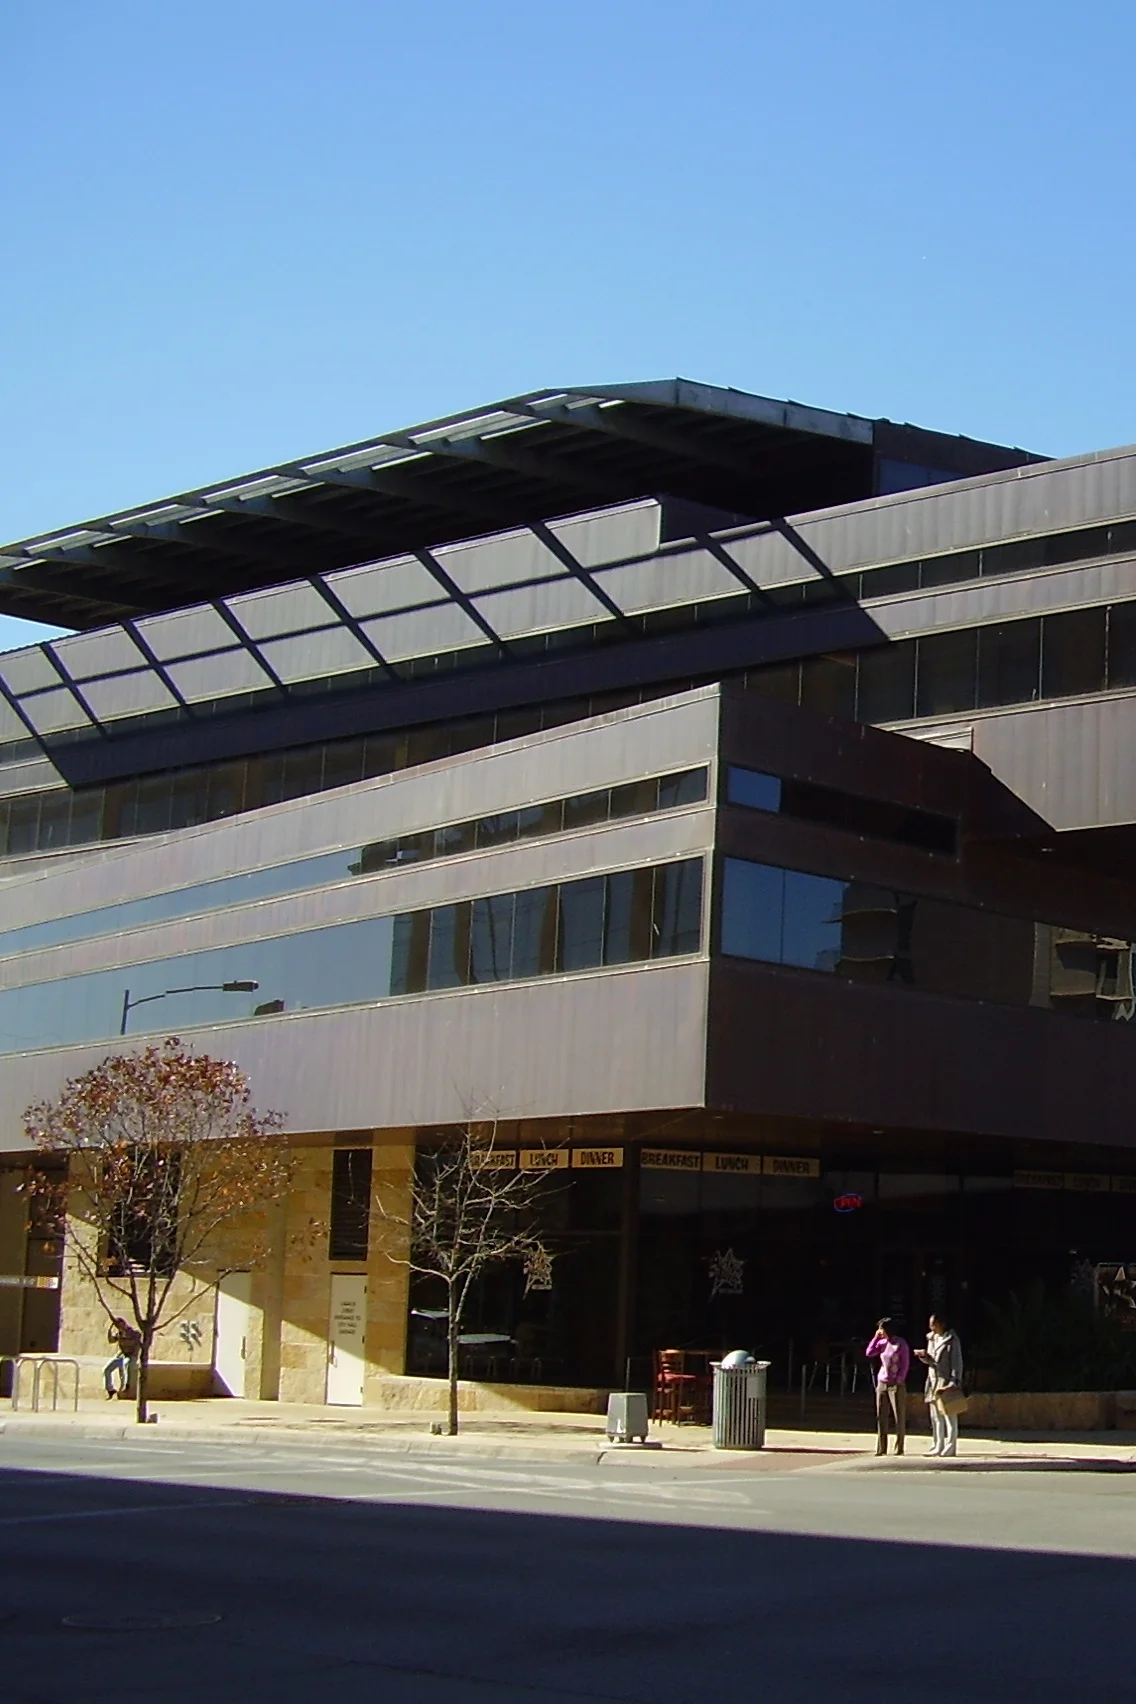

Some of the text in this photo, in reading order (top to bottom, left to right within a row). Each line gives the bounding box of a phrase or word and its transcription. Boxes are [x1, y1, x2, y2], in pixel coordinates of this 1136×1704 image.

[580, 1151, 615, 1165] DINNER
[641, 1152, 810, 1174] BREAKFAST LUNCH DINNER
